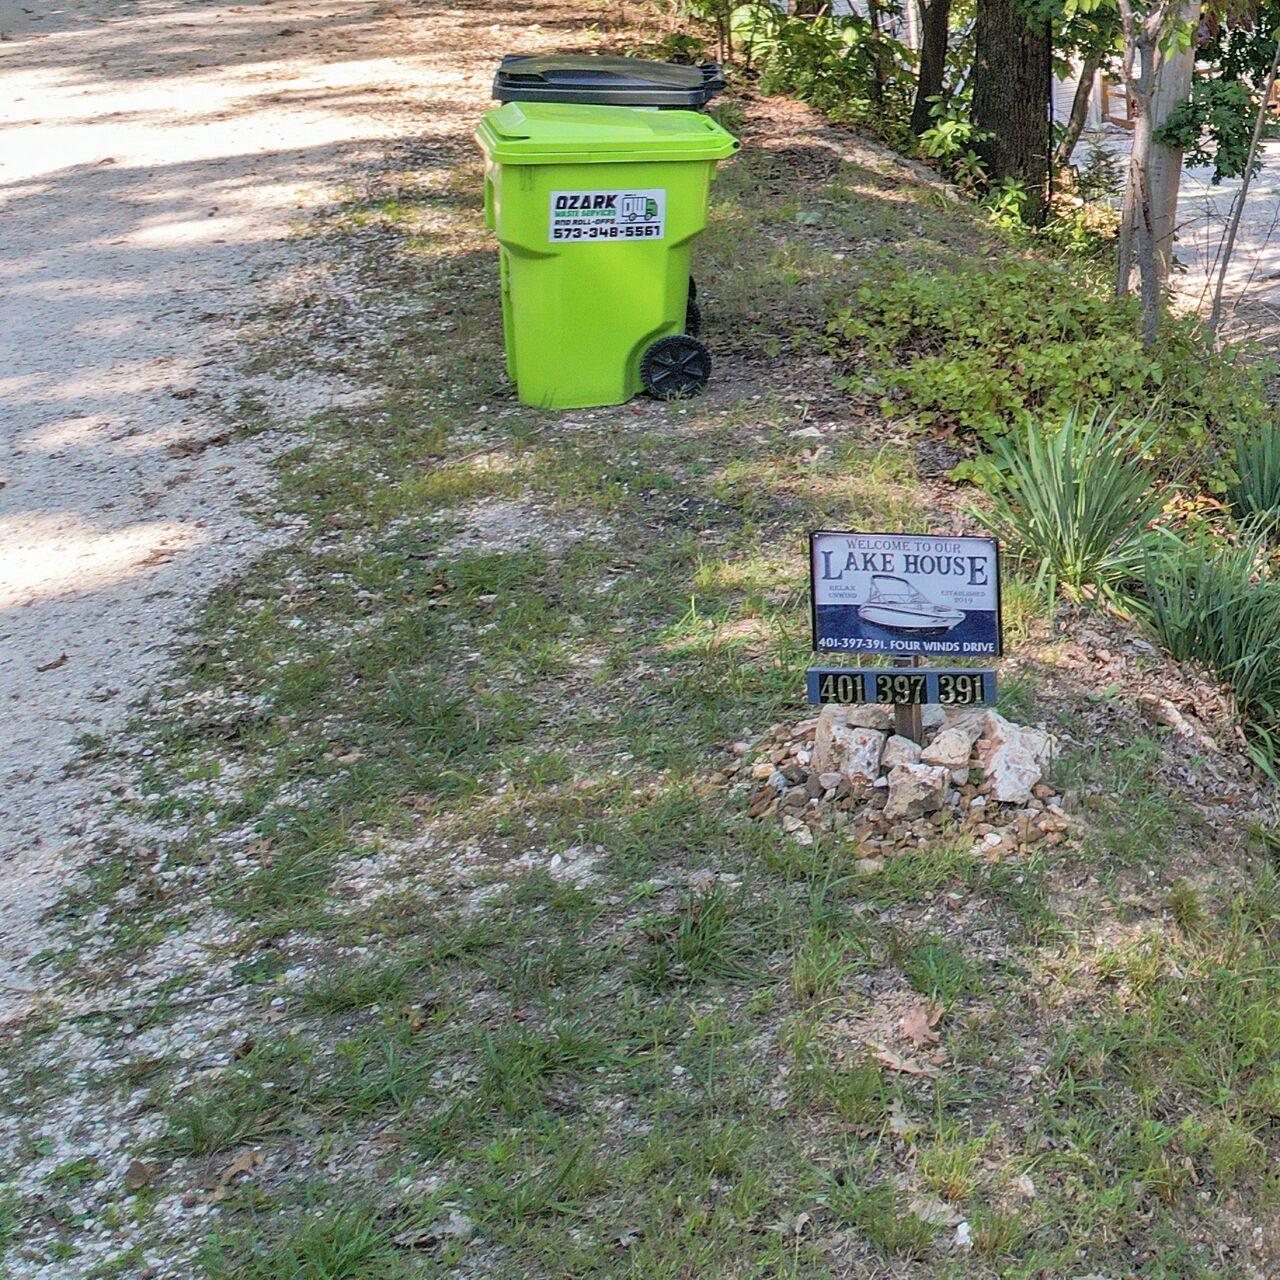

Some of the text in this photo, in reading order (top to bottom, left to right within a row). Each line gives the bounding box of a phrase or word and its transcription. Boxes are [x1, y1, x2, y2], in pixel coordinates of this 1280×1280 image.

[555, 195, 618, 209] OZARK
[582, 209, 616, 217] SERVICES
[554, 226, 660, 239] 573-348-5561
[846, 538, 961, 553] WELCOME TO OUR
[821, 550, 988, 586] LAKE HOUSE
[890, 640, 921, 650] FOUR
[923, 641, 960, 652] WINDS
[963, 642, 995, 652] DRIVE
[821, 674, 984, 704] 401 397 391
